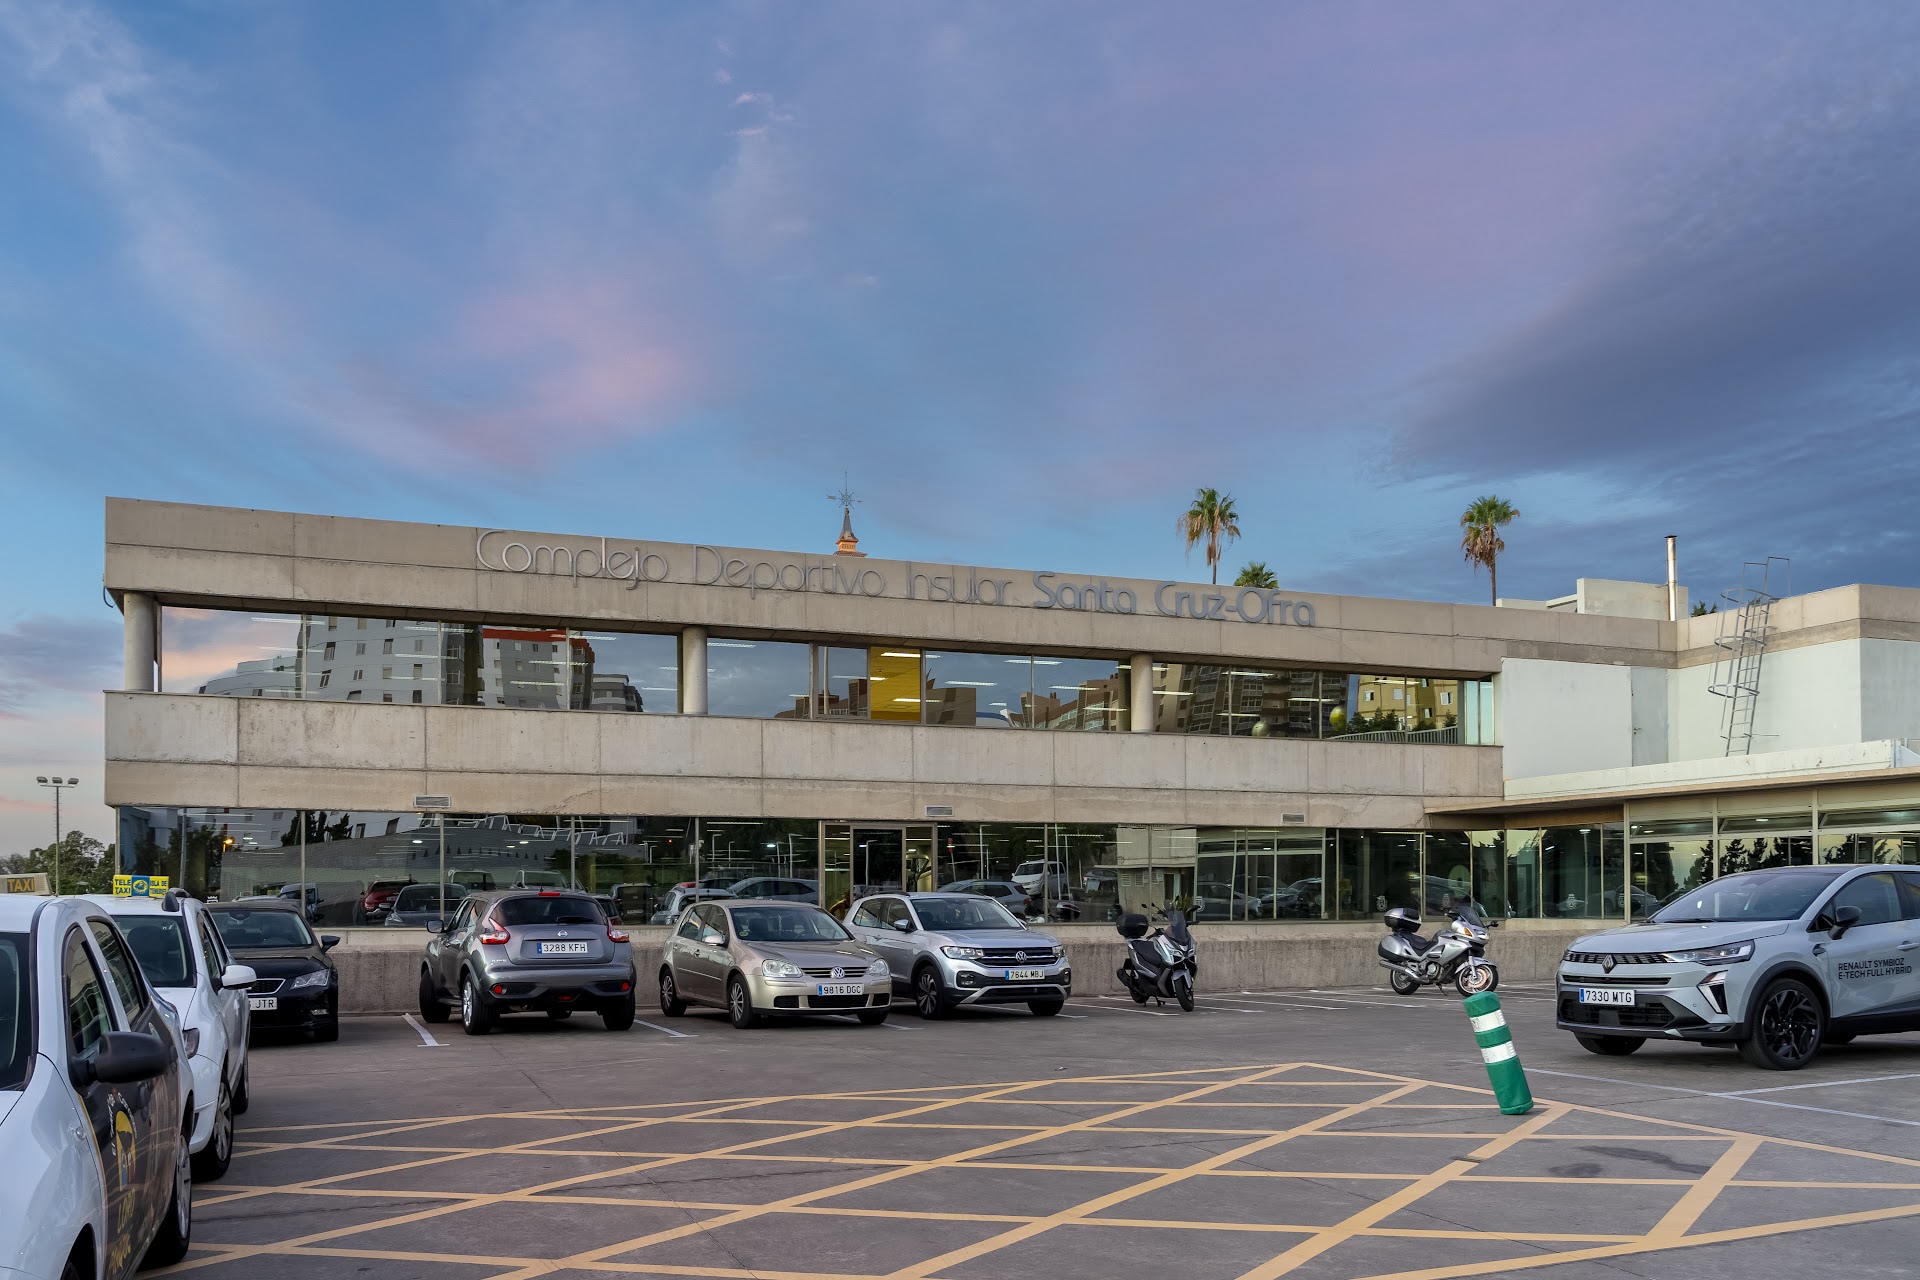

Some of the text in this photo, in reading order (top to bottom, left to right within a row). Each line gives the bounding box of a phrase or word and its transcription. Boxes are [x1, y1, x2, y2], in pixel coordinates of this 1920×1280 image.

[476, 529, 1316, 627] Complejo Deportivo Insular Santa Cruz-Ofra
[7, 878, 34, 892] TAXI
[543, 943, 586, 952] 3288 KFH
[1838, 957, 1905, 971] RENAULT SYMBIOZ
[1010, 971, 1028, 979] 7644
[1838, 965, 1912, 980] E-TECH FULL HYBRID
[823, 985, 861, 995] 9816 DGC
[1585, 990, 1632, 1003] 7330 MTG
[255, 999, 274, 1009] JTR
